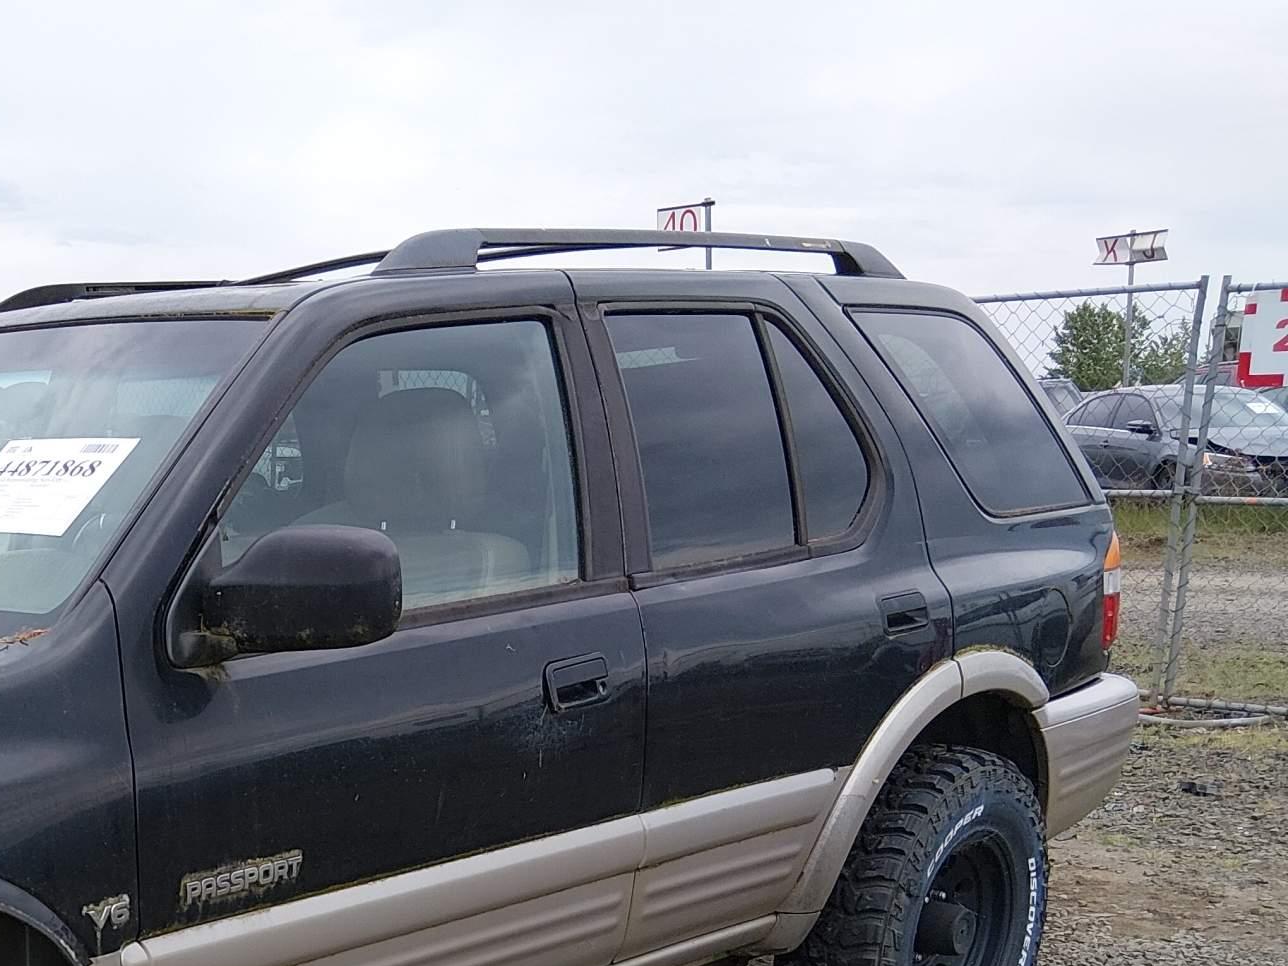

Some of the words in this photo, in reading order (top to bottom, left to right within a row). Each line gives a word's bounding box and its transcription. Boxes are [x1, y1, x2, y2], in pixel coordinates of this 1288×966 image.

[926, 804, 985, 879] COOPER
[186, 856, 302, 904] PASSPORT
[86, 901, 131, 929] V6
